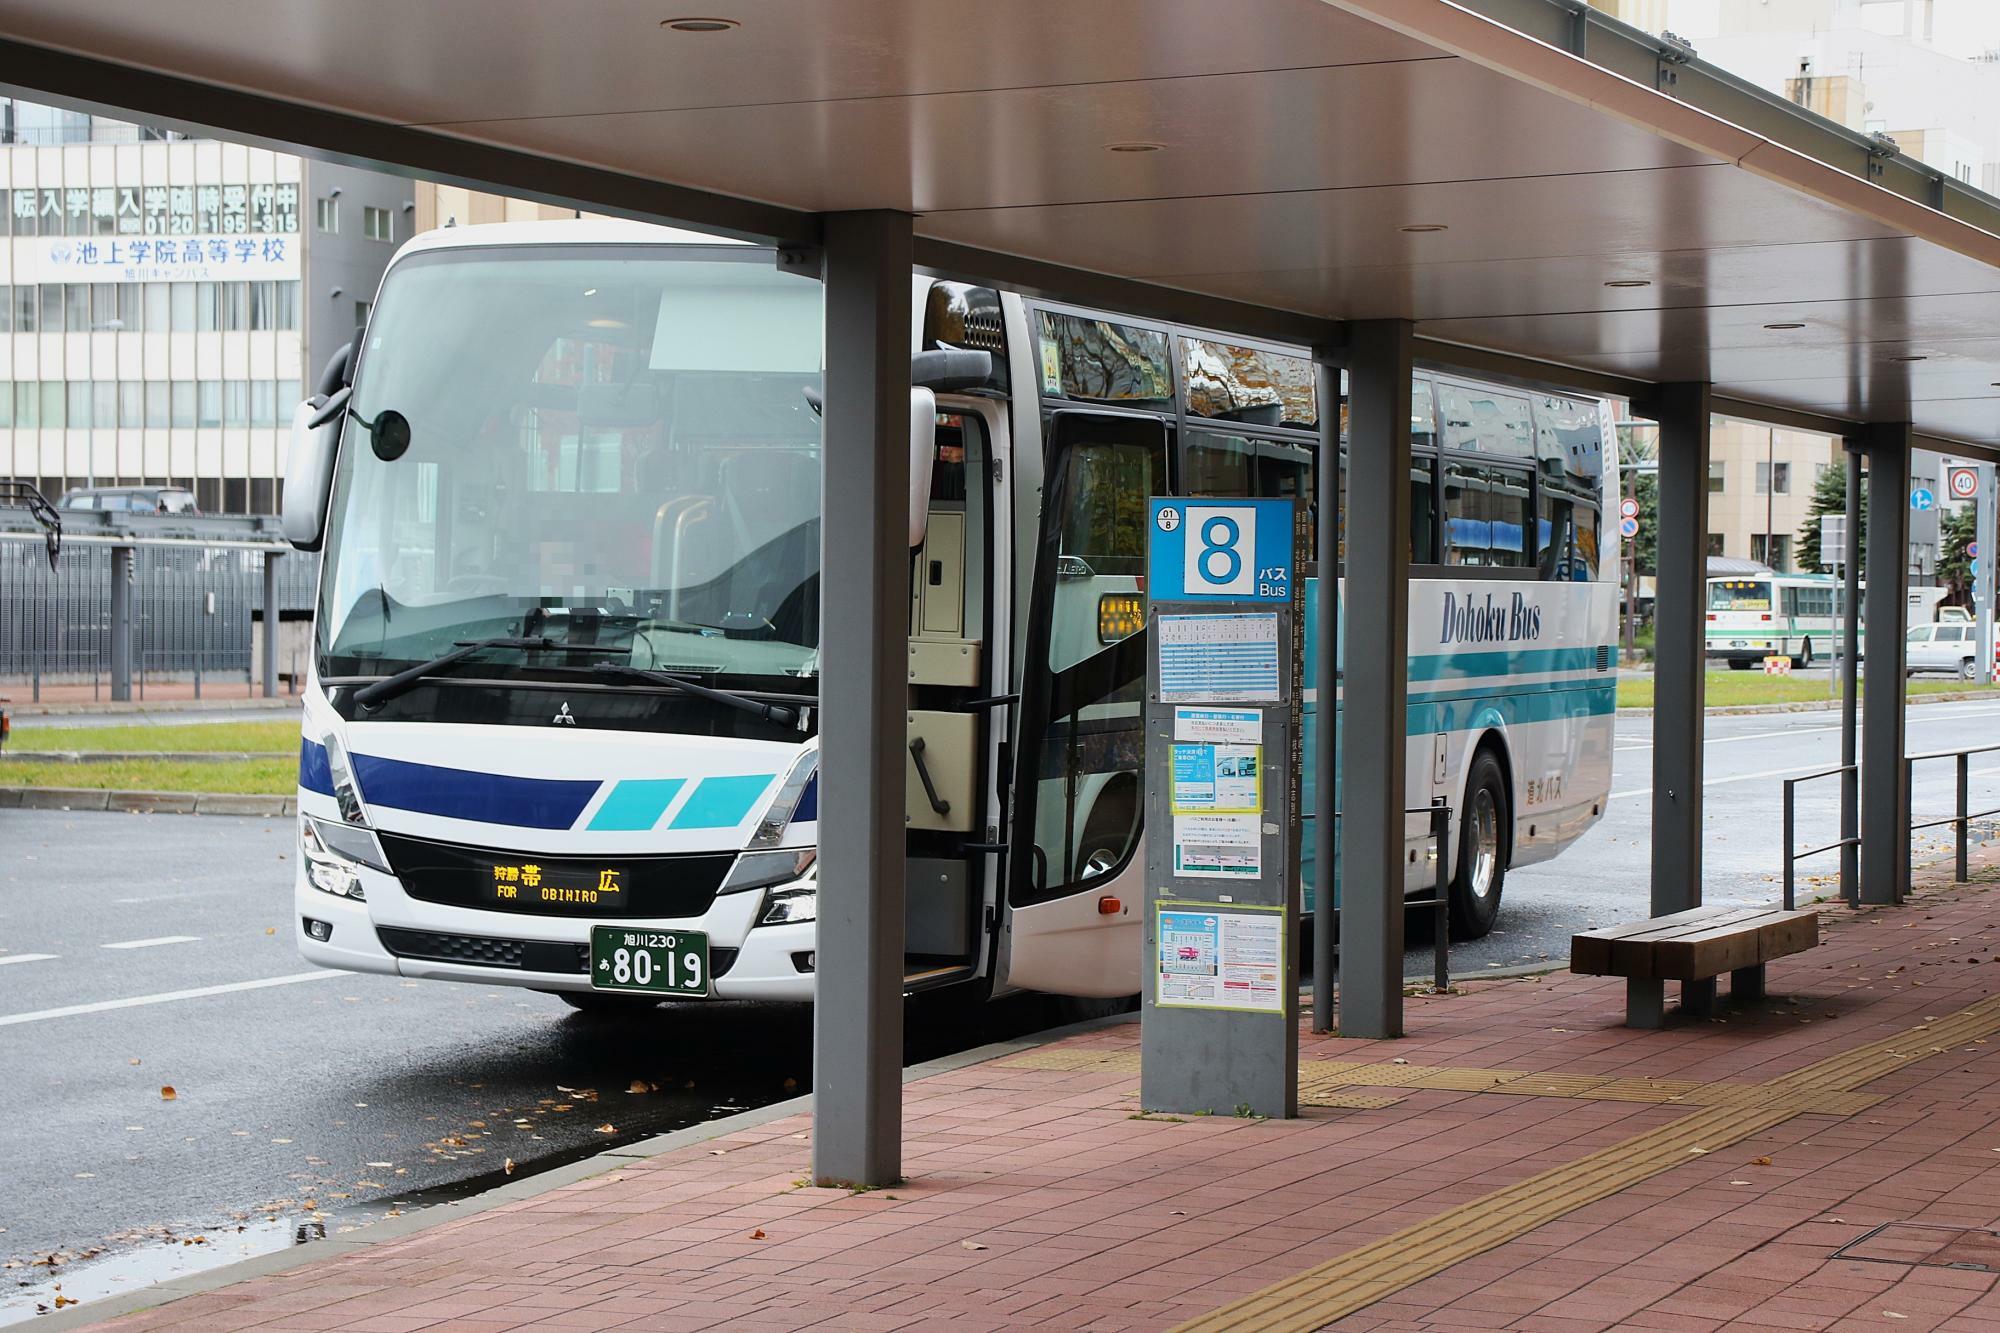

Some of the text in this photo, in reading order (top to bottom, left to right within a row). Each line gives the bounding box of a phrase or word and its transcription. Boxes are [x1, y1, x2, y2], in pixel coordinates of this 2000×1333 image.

[76, 238, 286, 265] 池上学院高等学校
[124, 267, 209, 280] 旭川キャンパス
[1957, 477, 1971, 489] 40
[1163, 510, 1173, 518] 01
[1165, 521, 1171, 529] 8
[1198, 516, 1242, 585] 8
[1258, 567, 1287, 582] バス
[1259, 583, 1286, 597] Bus
[1440, 591, 1541, 644] Dohoku Bus
[497, 885, 598, 904] FOR OBIHIRO
[613, 947, 702, 989] 80-19
